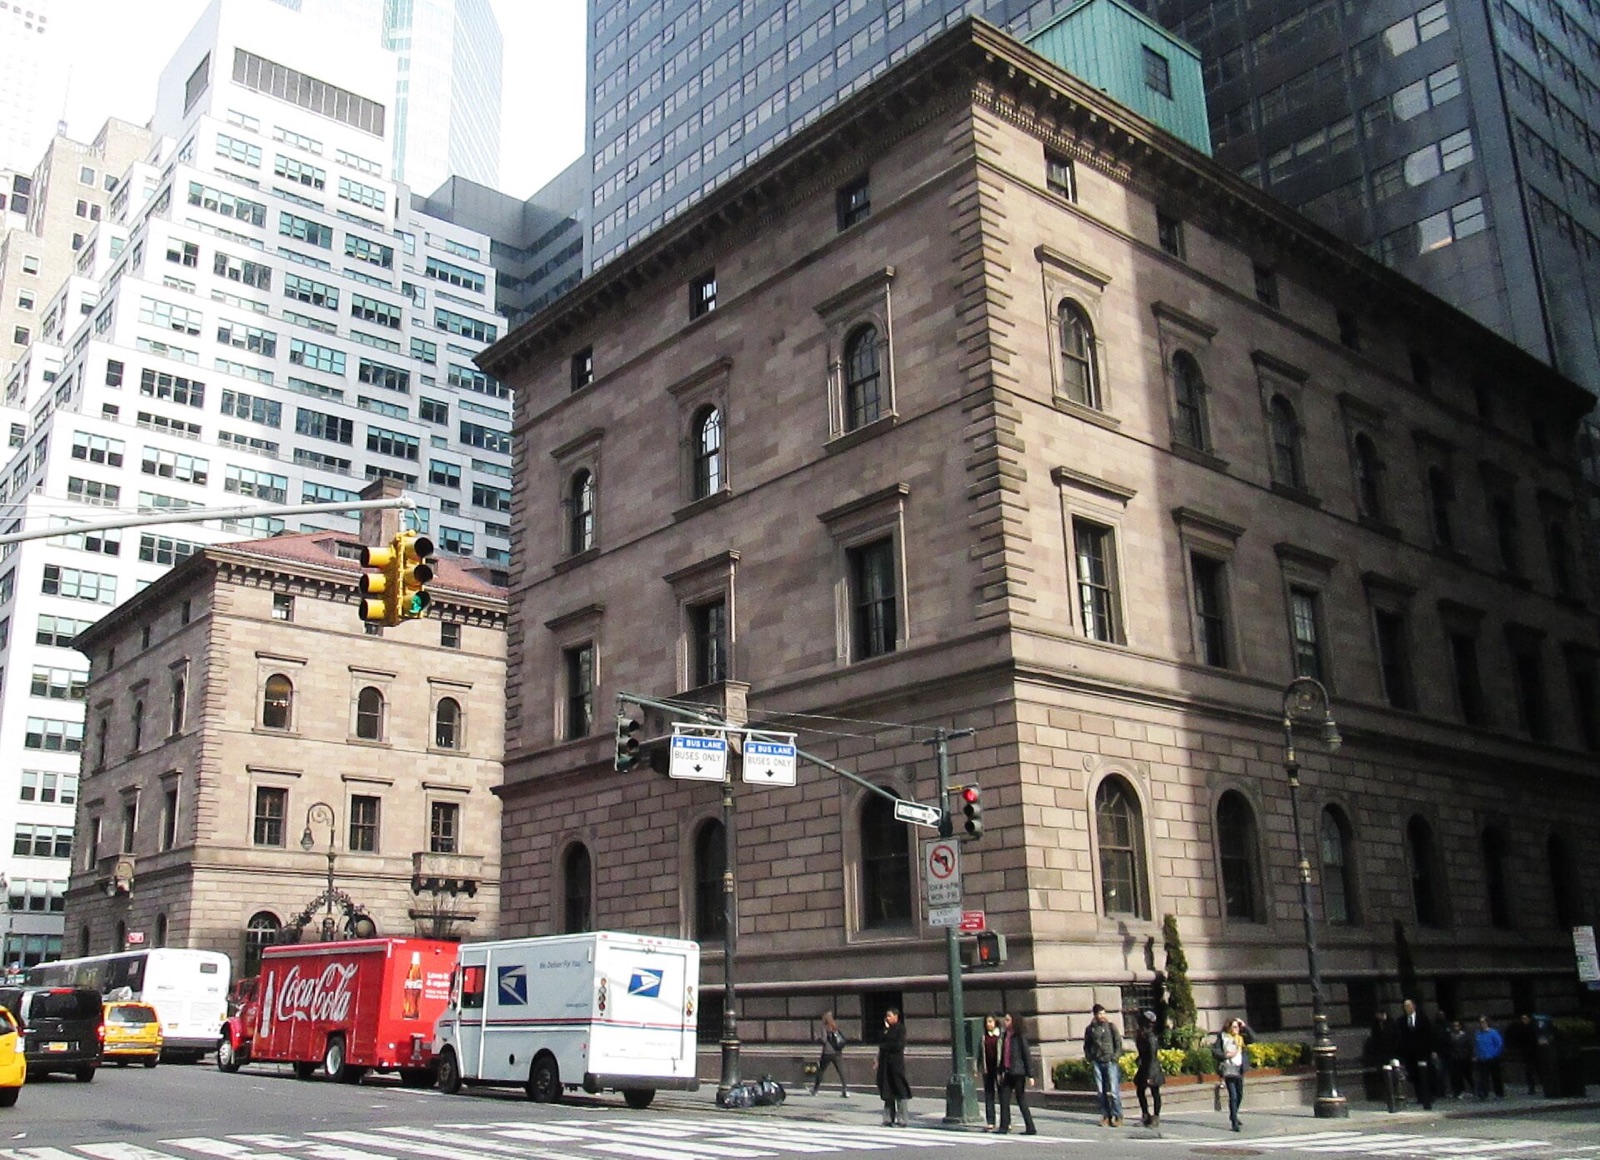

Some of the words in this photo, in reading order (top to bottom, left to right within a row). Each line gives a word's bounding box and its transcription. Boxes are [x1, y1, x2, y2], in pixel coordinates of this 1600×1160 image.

[686, 739, 700, 748] BUS
[702, 741, 722, 749] LANE
[757, 745, 771, 753] BUS
[772, 746, 792, 755] LANE
[674, 751, 699, 760] BUSES
[702, 753, 722, 762] ONLY
[747, 756, 771, 766] BUSES
[773, 758, 792, 767] ONLY
[900, 806, 913, 815] ONE
